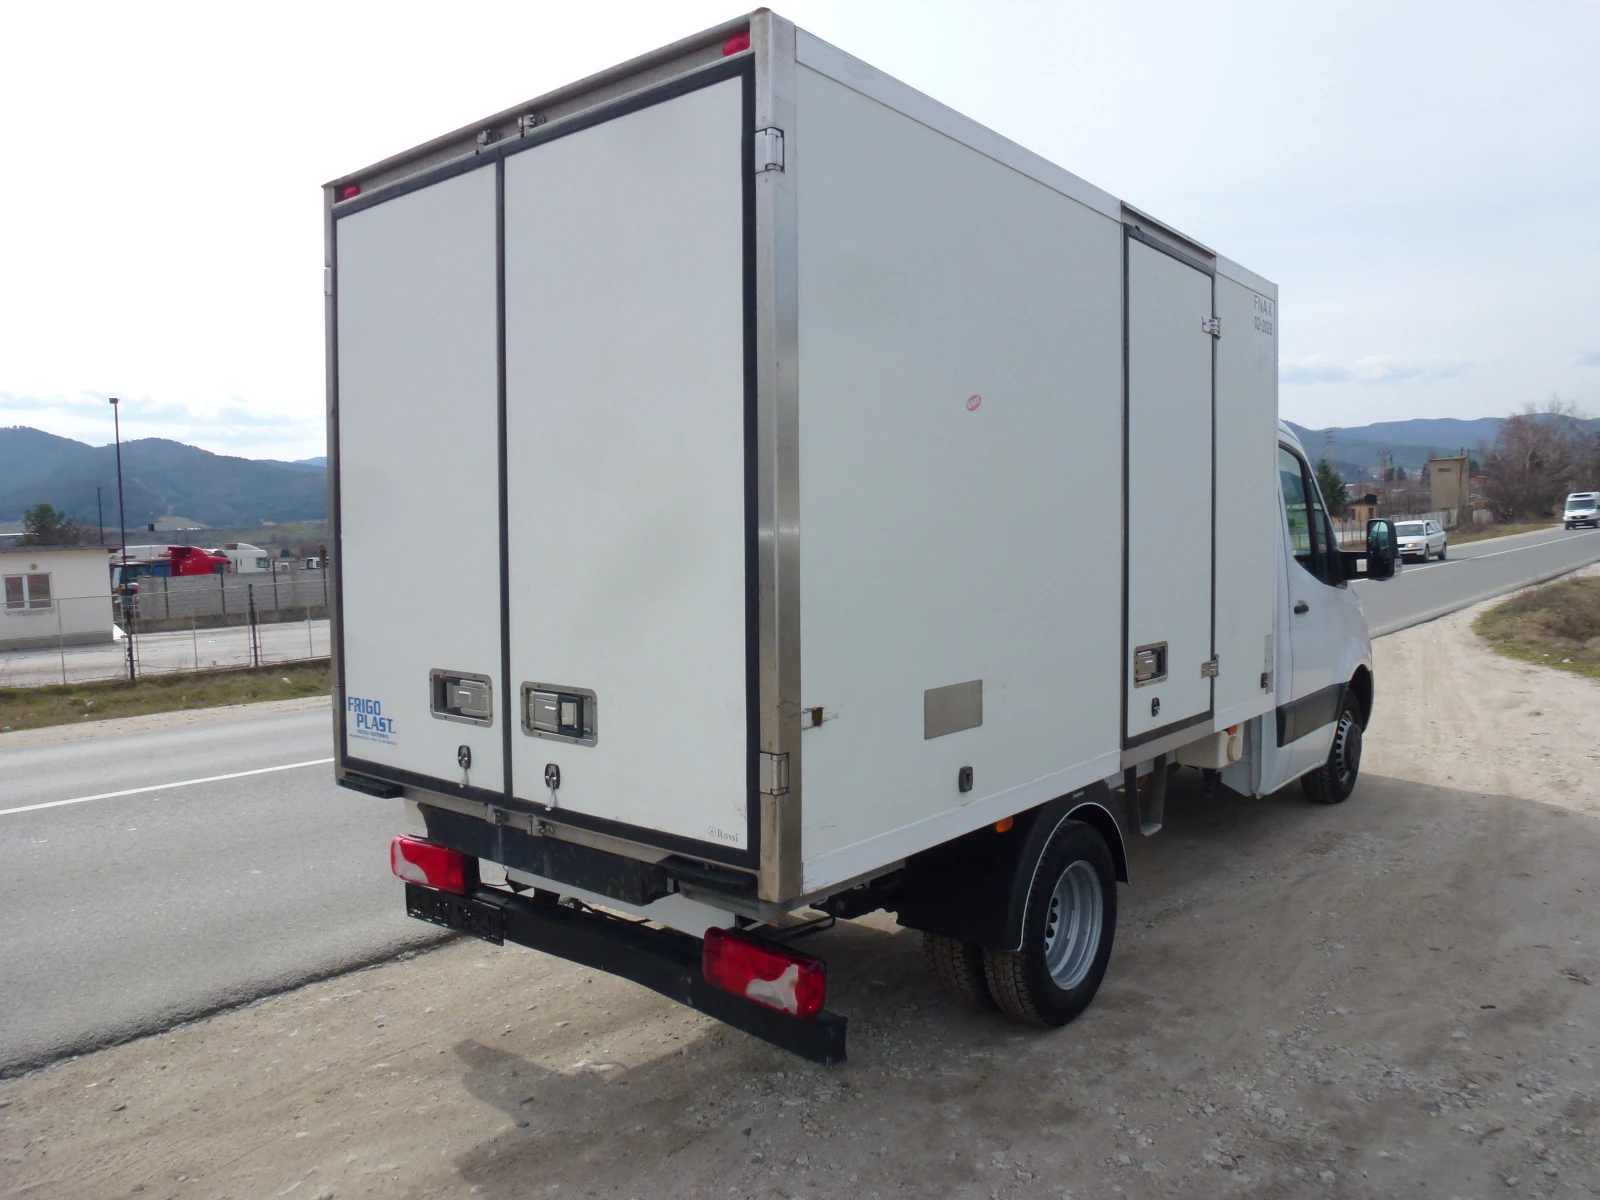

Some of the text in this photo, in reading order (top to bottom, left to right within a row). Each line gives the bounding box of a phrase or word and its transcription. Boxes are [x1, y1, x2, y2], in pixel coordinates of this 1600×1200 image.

[1254, 295, 1272, 316] FNAX
[348, 697, 381, 715] FRIGO
[357, 713, 393, 733] PLAST
[718, 829, 739, 842] Rossi
